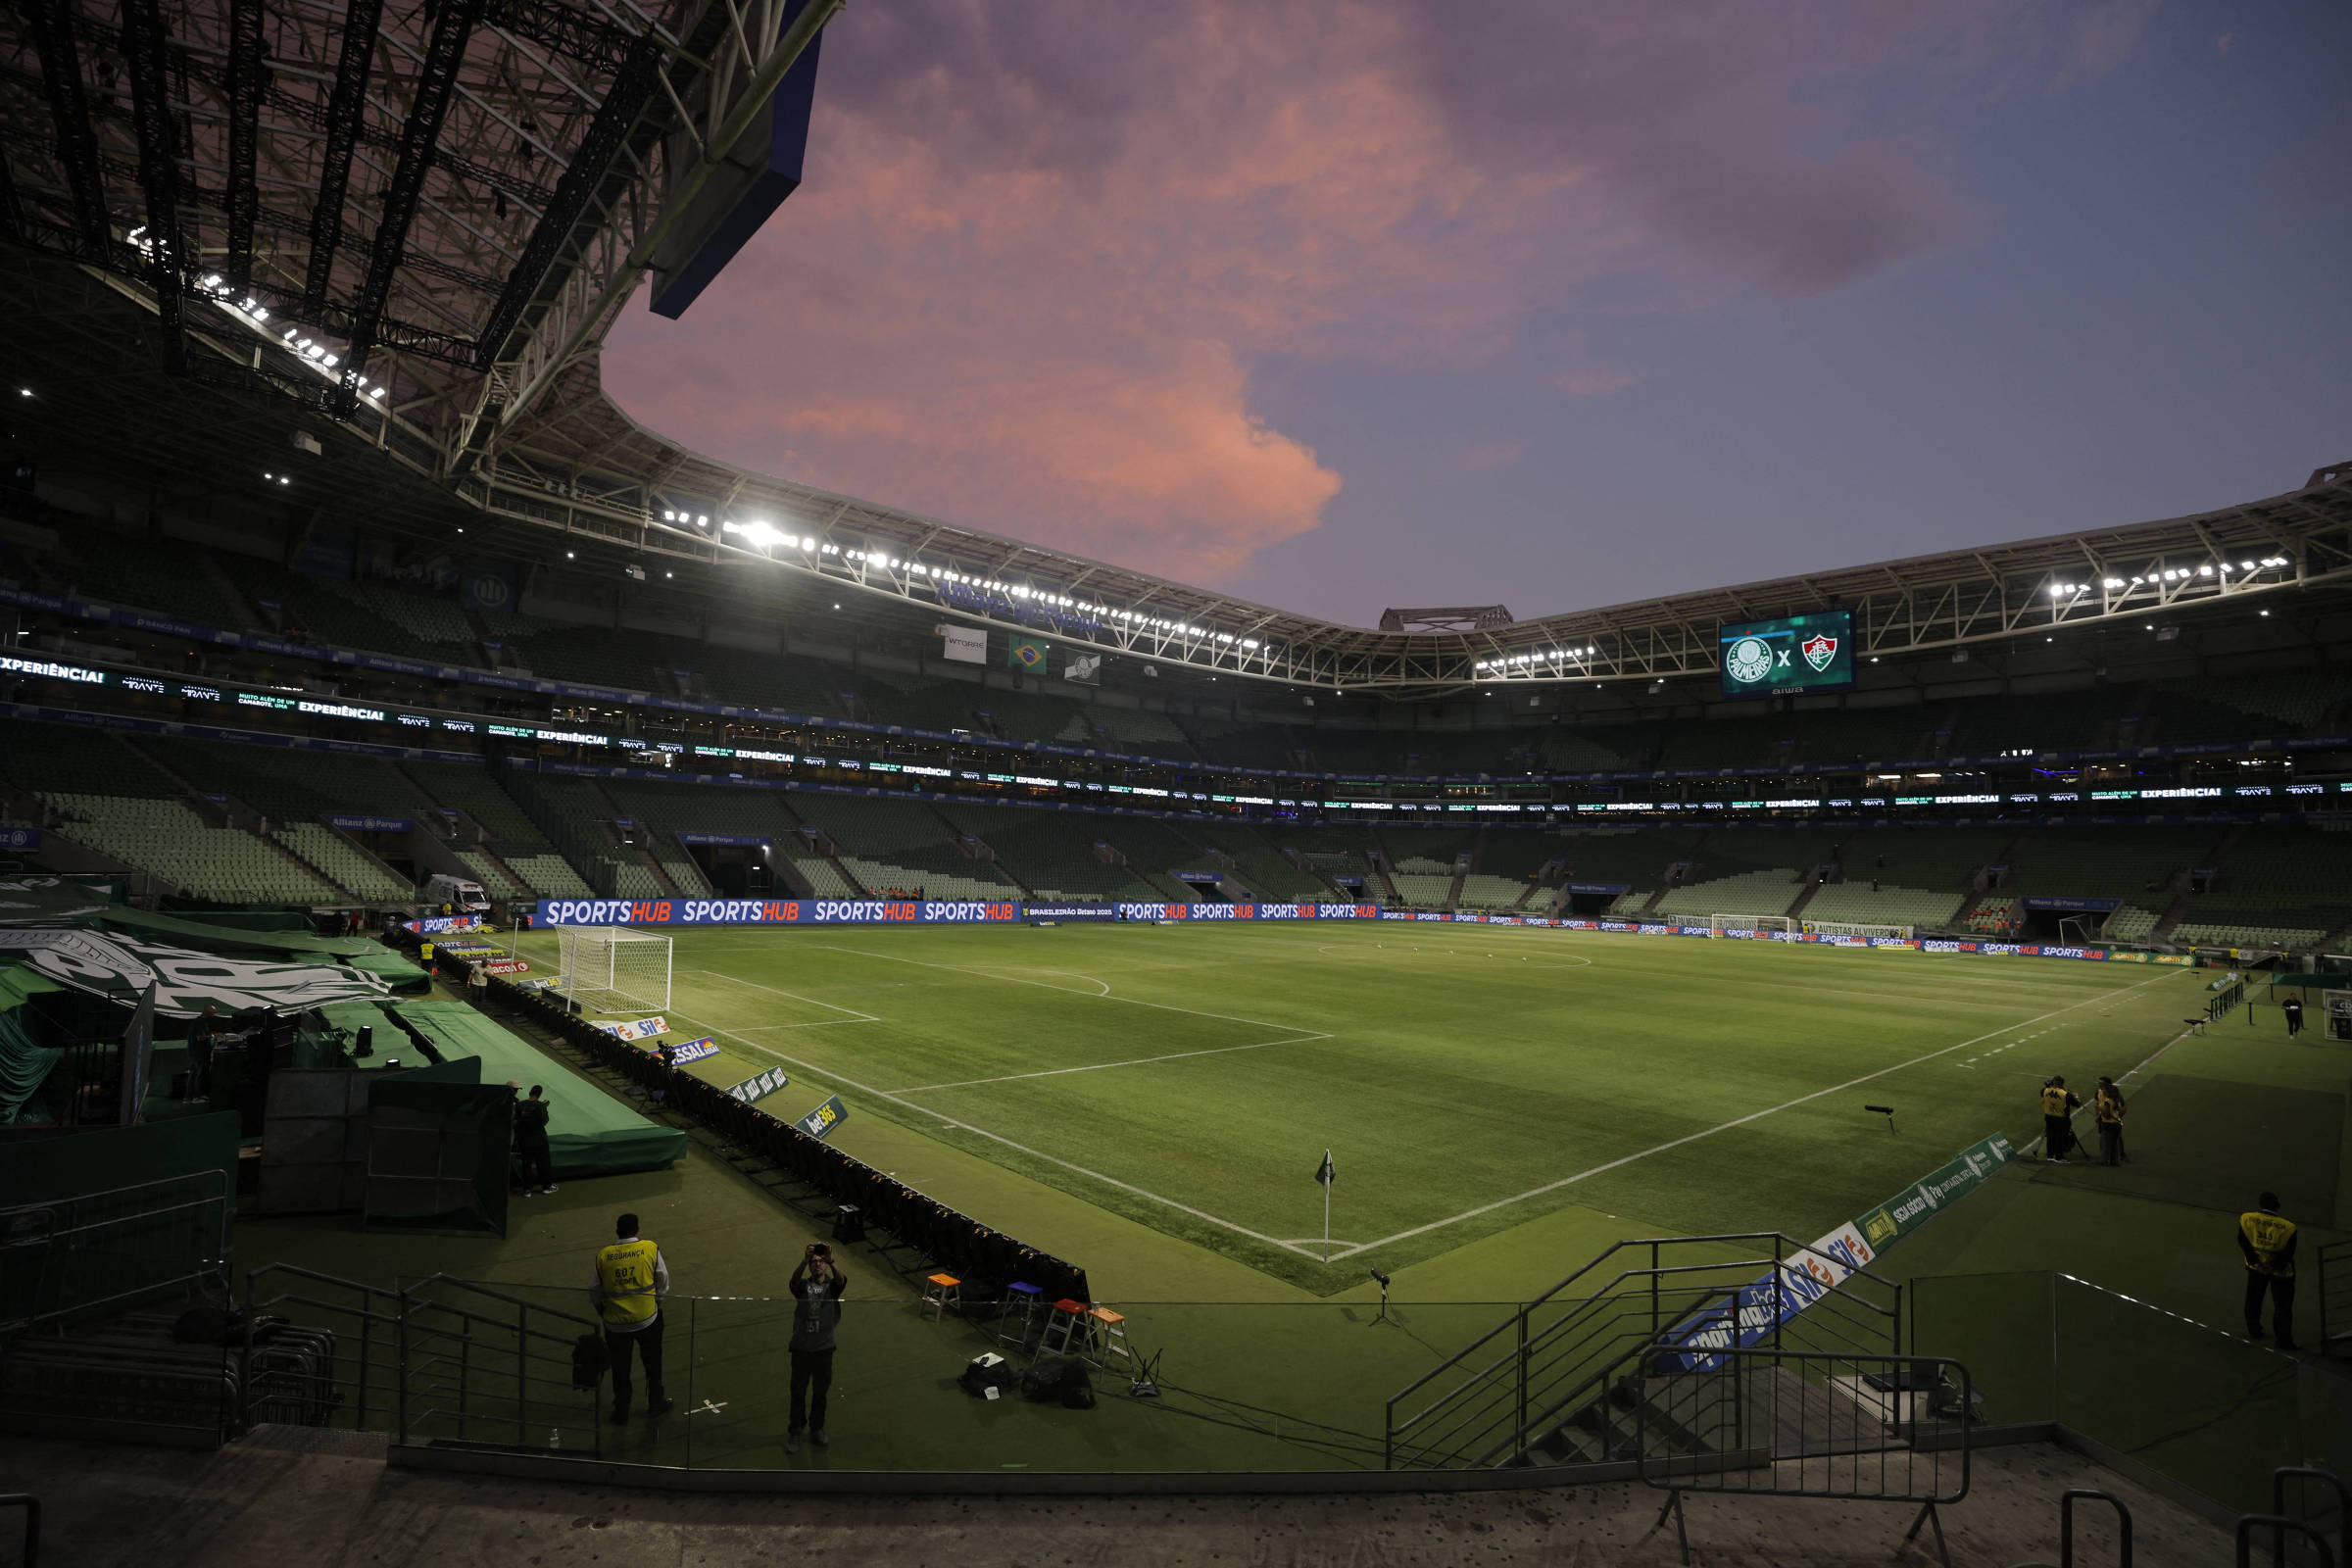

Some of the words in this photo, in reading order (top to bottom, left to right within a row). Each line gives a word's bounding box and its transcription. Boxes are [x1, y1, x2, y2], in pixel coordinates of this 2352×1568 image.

[1772, 686, 1803, 695] aiwa
[298, 701, 384, 720] EXPERIÊNCIA!
[537, 730, 609, 746] EXPERIÊNCIA!
[736, 749, 795, 762] EXPERIÊNCIA!
[903, 764, 952, 777] EXPERIÊNCIA!
[1936, 794, 1999, 805] EXPERIÊNCIA!
[2140, 787, 2222, 799] EXPERIÊNCIA!
[1765, 799, 1820, 808] EXPERIÊNCIA!
[333, 817, 363, 827] Allianz
[546, 901, 672, 923] SPORTSHUB
[682, 901, 799, 921] SPORTSHUB
[814, 902, 916, 921] SPORTSHUB
[924, 903, 1013, 921] SPORTSHUB
[1030, 906, 1076, 915] BRASILEIRÃO
[1118, 904, 1187, 919] SPORTSHUB
[1193, 904, 1253, 919] SPORTSHUB
[1261, 904, 1315, 918] SPORTSHUB
[1320, 904, 1377, 918] SPORTSHUB
[1417, 912, 1451, 921] SPORTSHUB
[424, 917, 468, 932] SPORTSHUB
[1818, 925, 1852, 934] AUTISTAS
[1728, 929, 1769, 939] SPORTSHUB
[1773, 932, 1817, 941] SPORTSHUB
[1821, 934, 1867, 944] SPORTSHUB
[1925, 940, 1976, 951] SPORTSHUB
[1984, 942, 2038, 955] SPORTSHUB
[2043, 947, 2103, 959] SPORTSHUB
[638, 1019, 658, 1036] Sil
[671, 1042, 706, 1065] SSAÍ
[805, 1104, 837, 1135] bet365
[1928, 1185, 1945, 1200] Pay
[607, 1249, 645, 1261] SEGURANÇA
[1828, 1239, 1859, 1275] Sil
[1787, 1262, 1822, 1304] Sil
